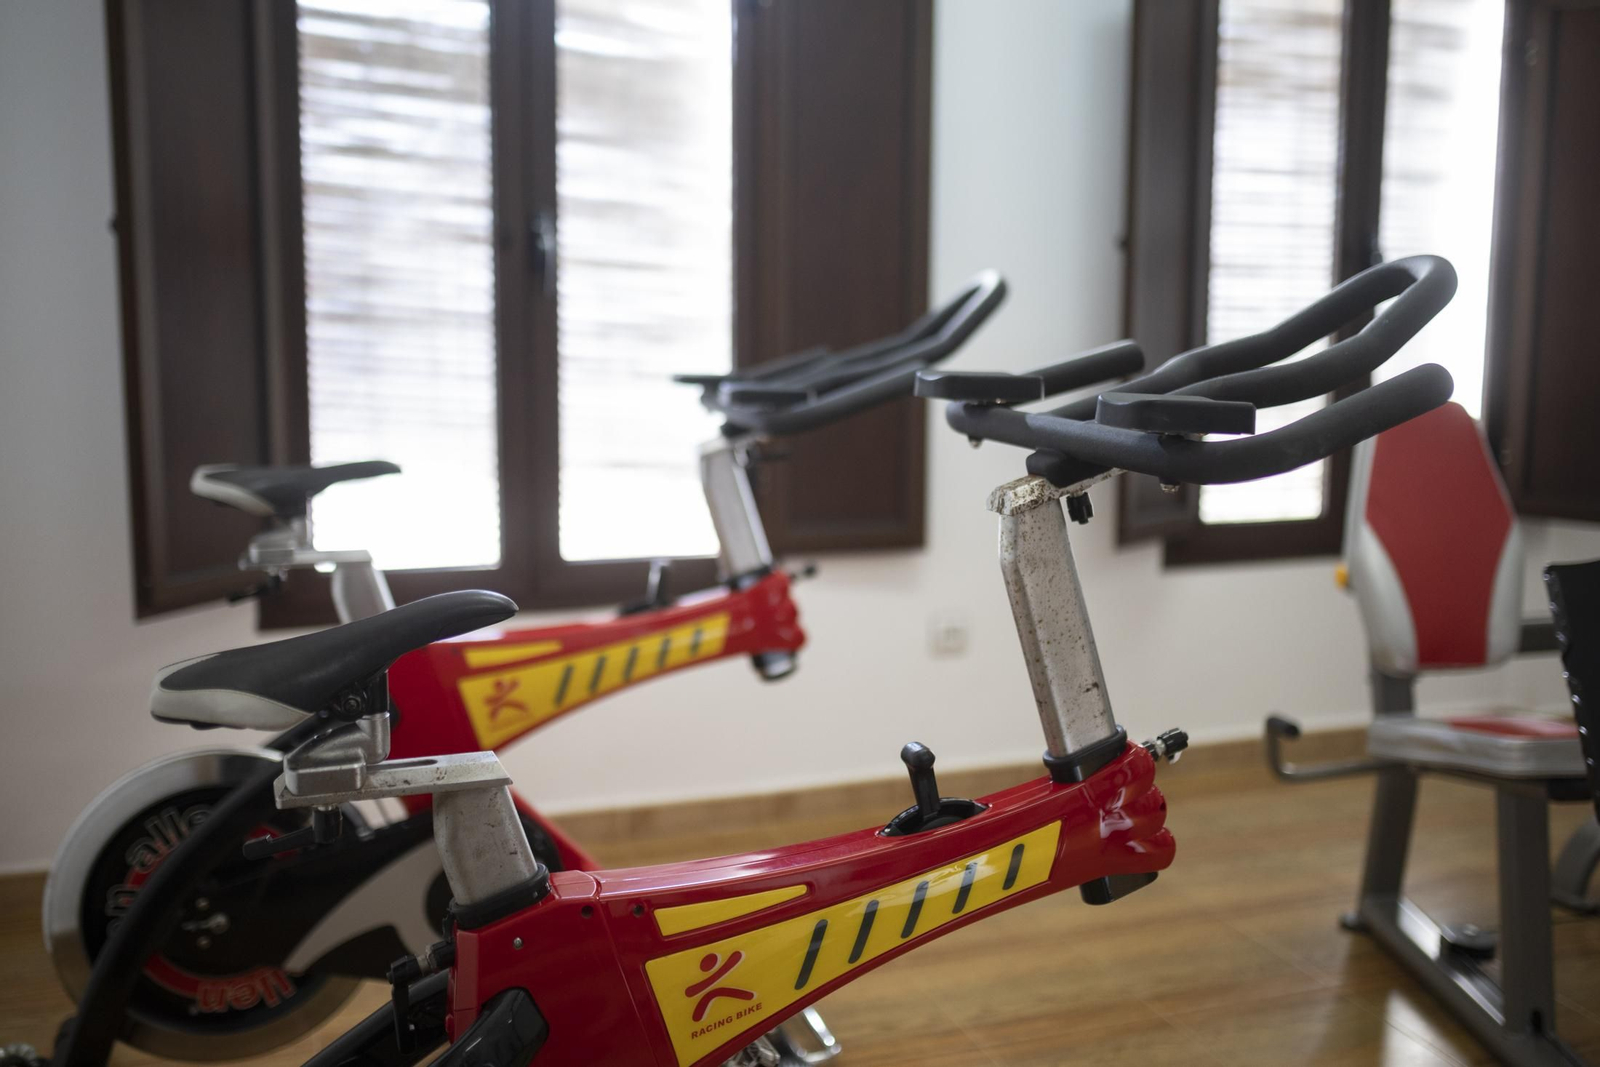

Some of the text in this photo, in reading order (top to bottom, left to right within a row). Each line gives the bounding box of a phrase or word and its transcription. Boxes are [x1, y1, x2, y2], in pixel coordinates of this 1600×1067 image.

[125, 804, 214, 873] alle
[198, 969, 297, 1013] llen
[691, 1002, 763, 1039] RACING BIKE
